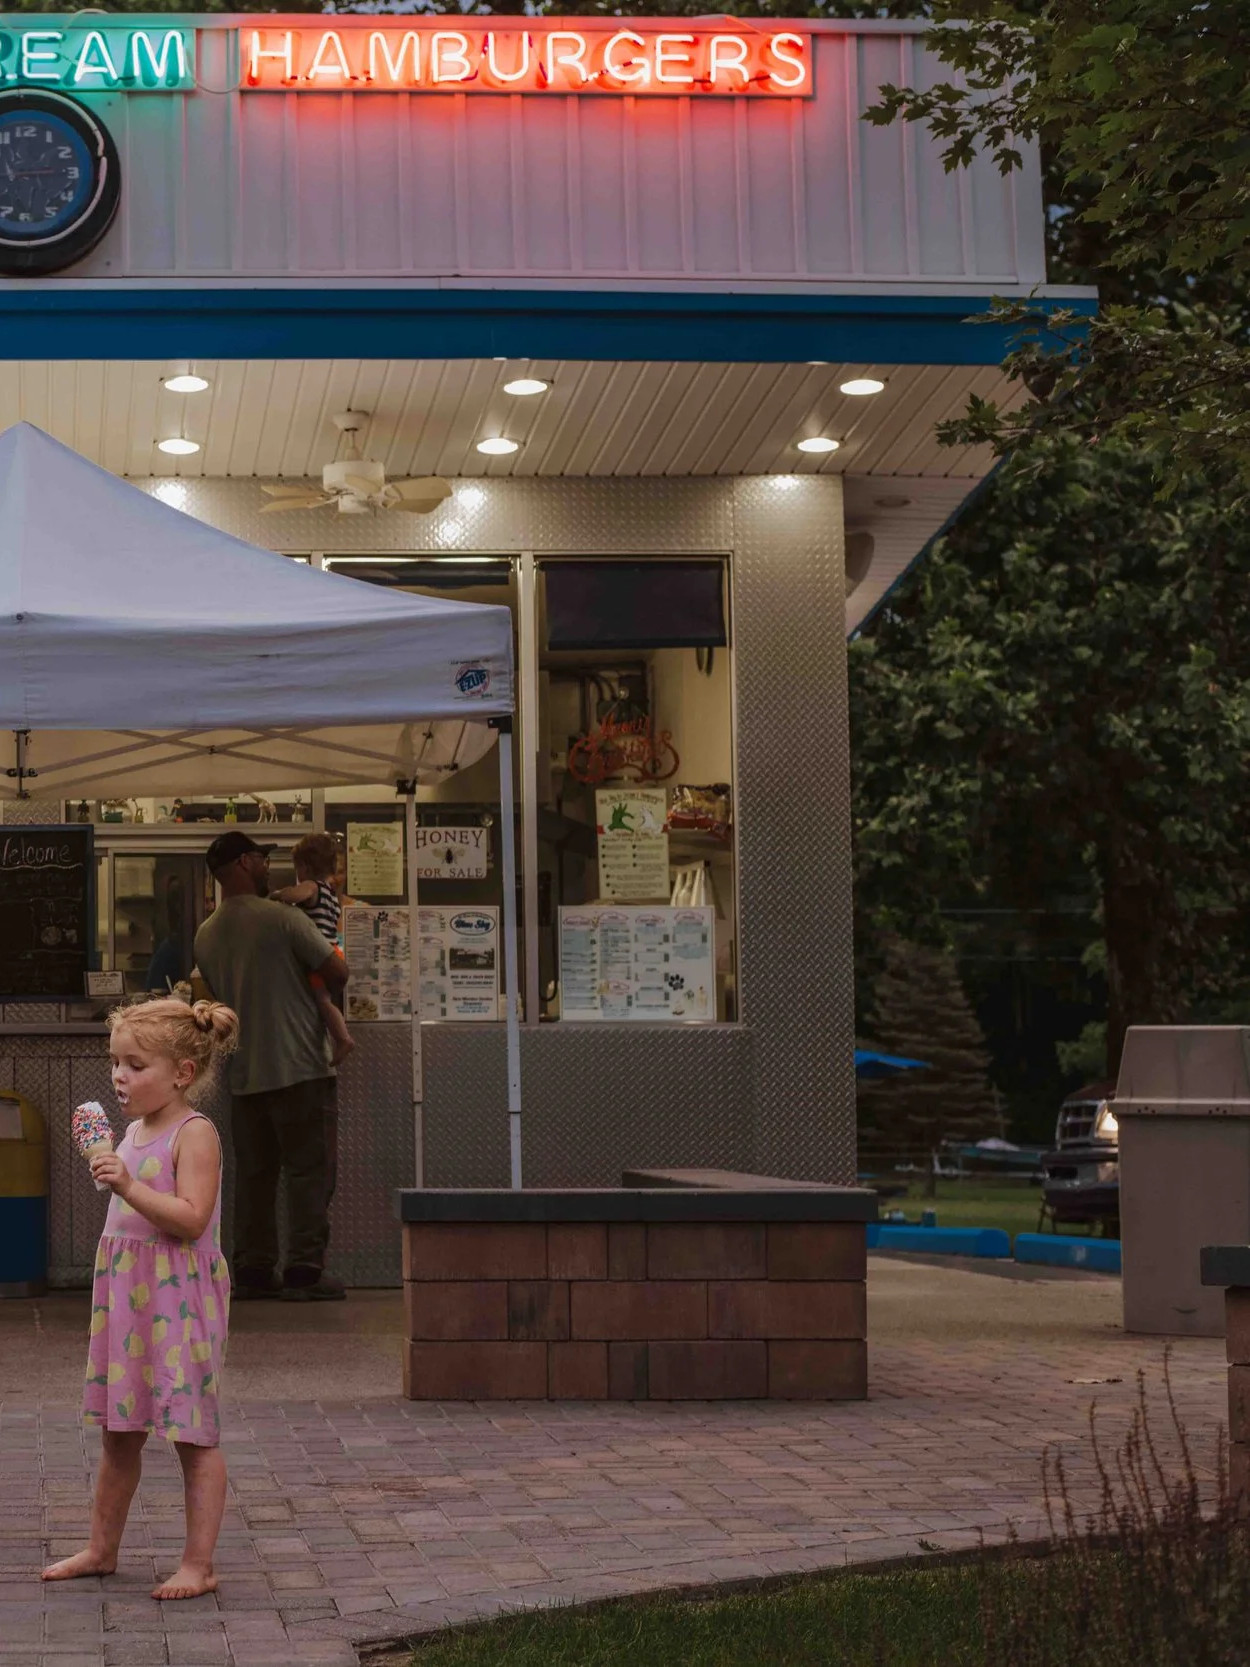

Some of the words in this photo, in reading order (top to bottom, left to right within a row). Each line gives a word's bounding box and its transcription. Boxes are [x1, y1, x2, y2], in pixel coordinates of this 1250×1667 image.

[249, 30, 807, 88] HAMBURGERS
[14, 126, 38, 138] 12
[45, 131, 53, 143] 1
[57, 146, 73, 159] 2
[67, 167, 80, 180] 3
[60, 190, 74, 203] 4
[0, 206, 14, 219] 7
[18, 212, 32, 223] 6
[45, 206, 59, 219] 5
[416, 829, 484, 850] HONEY
[417, 867, 442, 878] FOR
[449, 867, 485, 878] SALE
